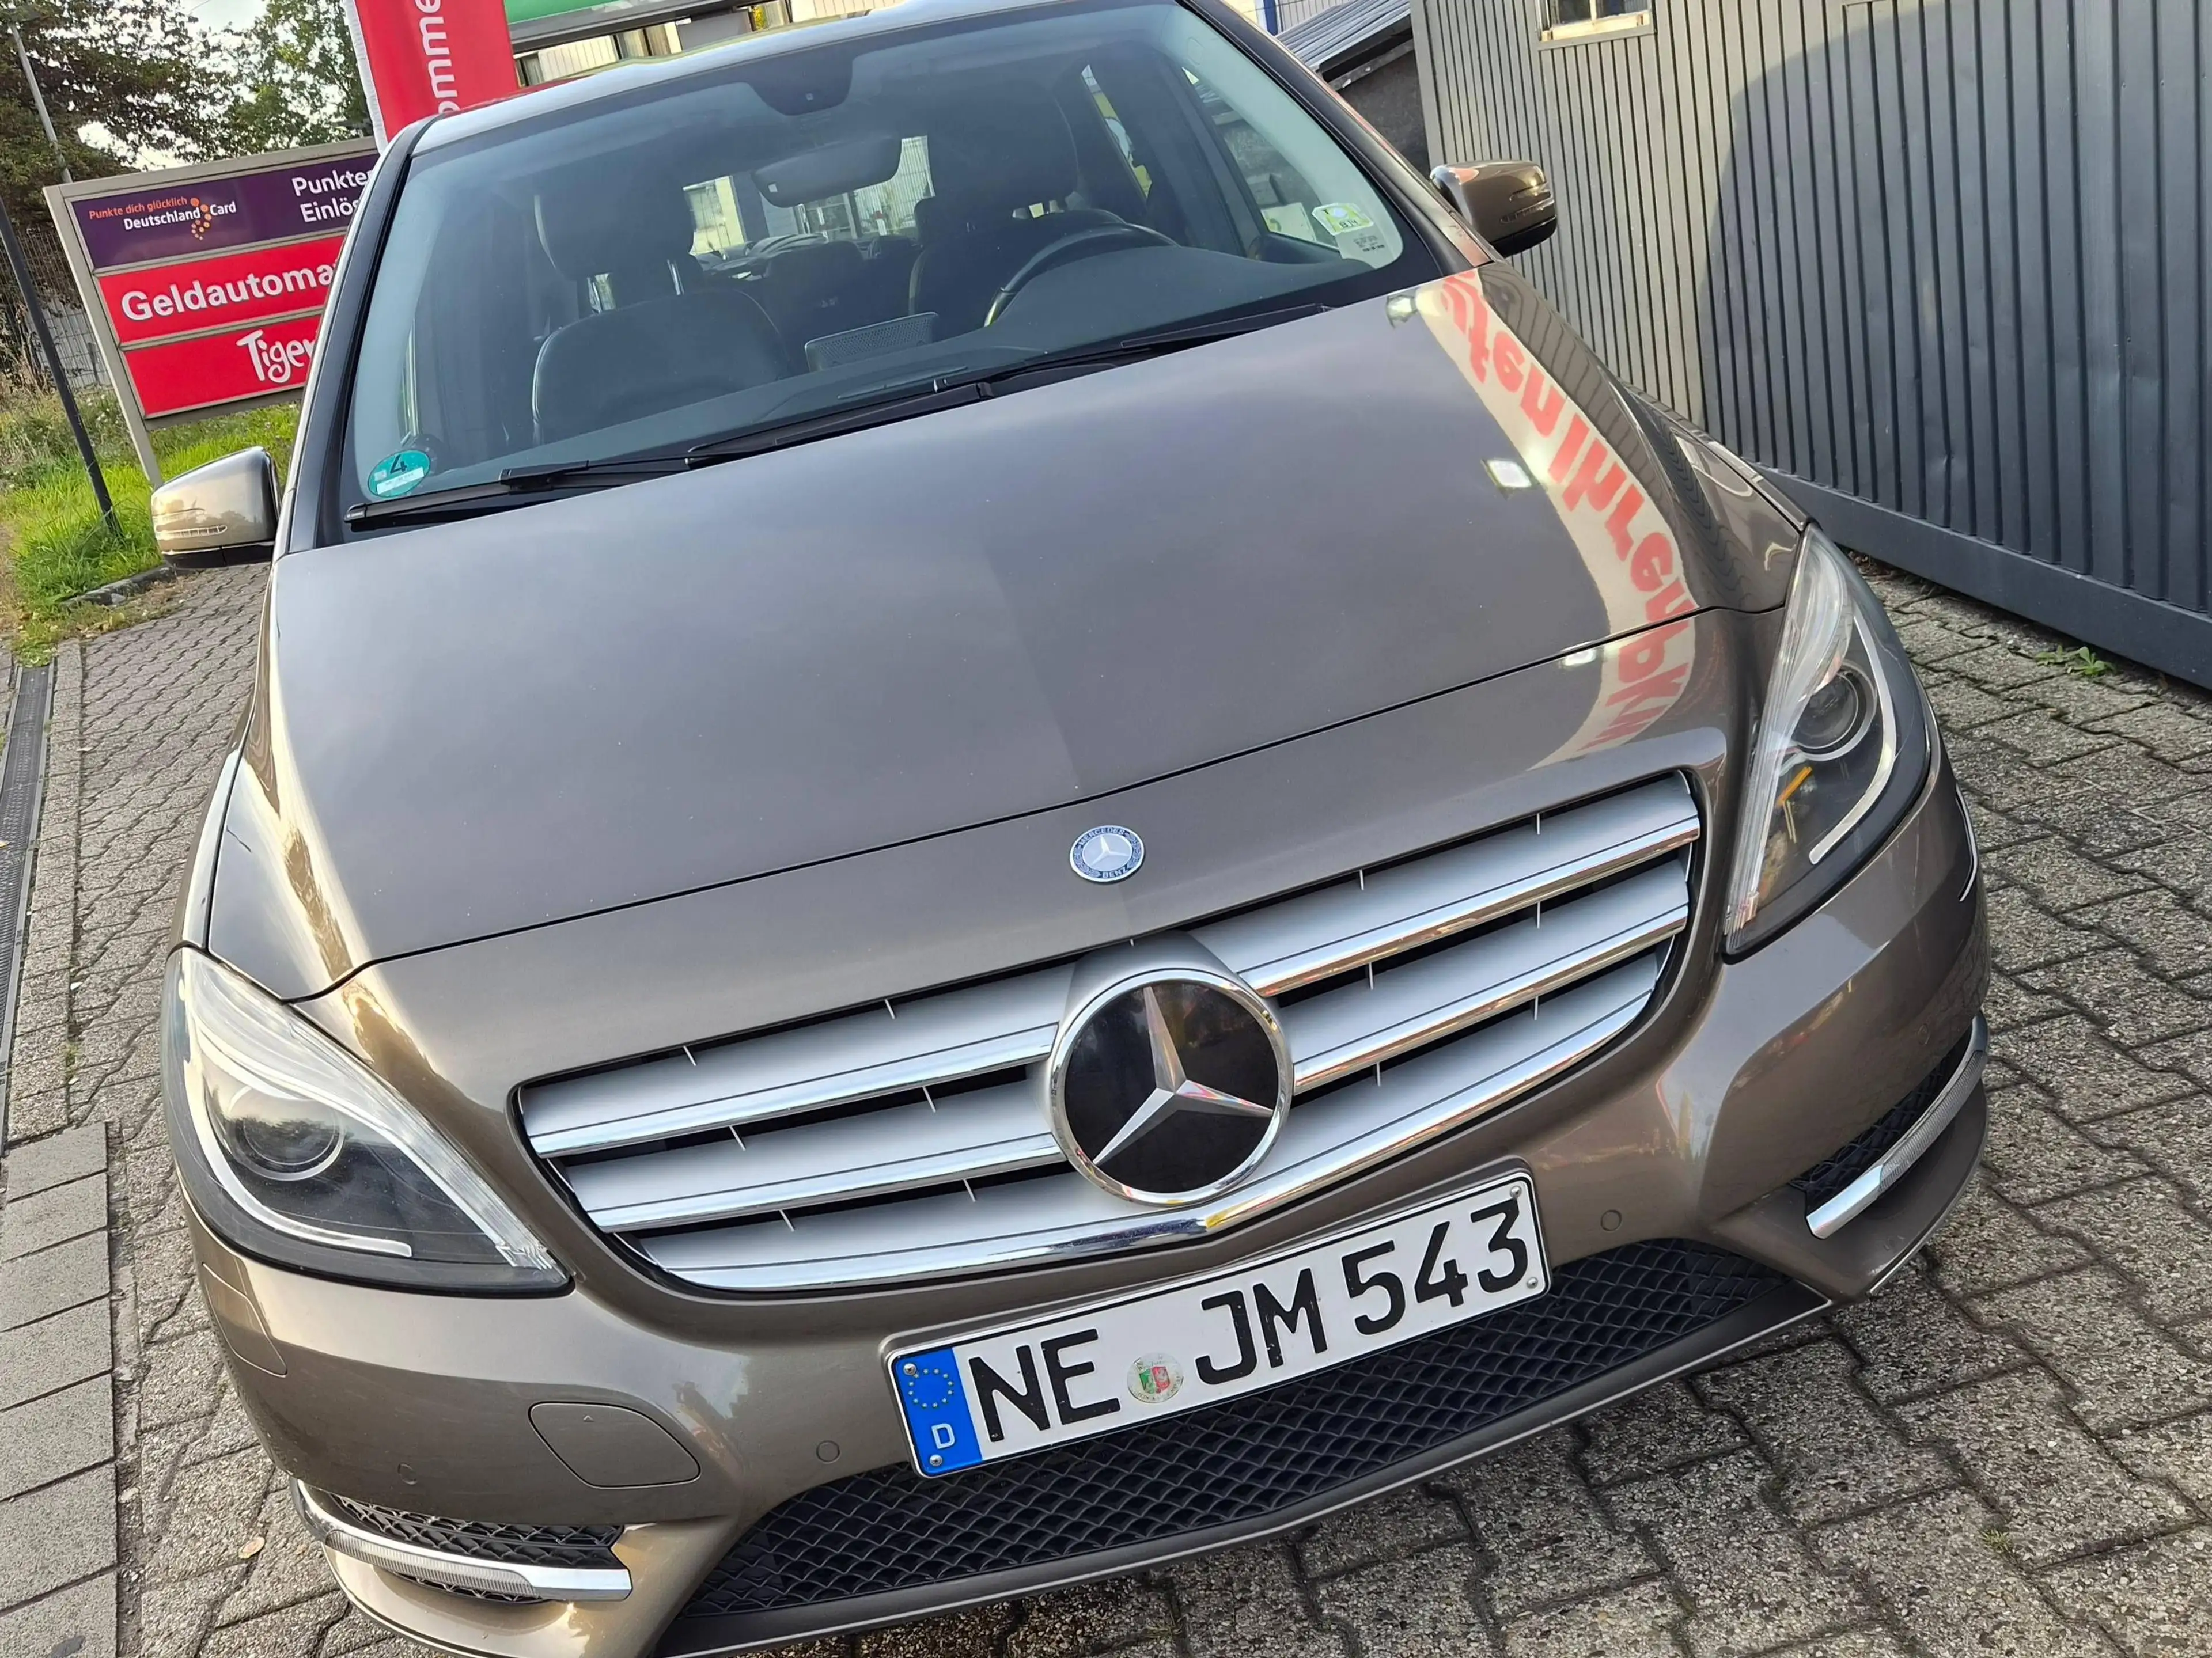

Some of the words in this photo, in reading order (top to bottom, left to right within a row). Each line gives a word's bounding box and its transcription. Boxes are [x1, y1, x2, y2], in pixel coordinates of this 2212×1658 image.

[89, 207, 123, 219] Punkte
[126, 204, 145, 214] dich
[147, 196, 187, 212] glücklich
[123, 207, 200, 230] Deutschland
[210, 202, 236, 216] Card
[122, 259, 337, 321] Geldautoma
[390, 454, 408, 474] 4
[1102, 864, 1129, 878] BENZ
[968, 1329, 1121, 1443] NE
[1195, 1268, 1328, 1385] JM
[1342, 1198, 1528, 1335] 543
[931, 1423, 956, 1450] D
